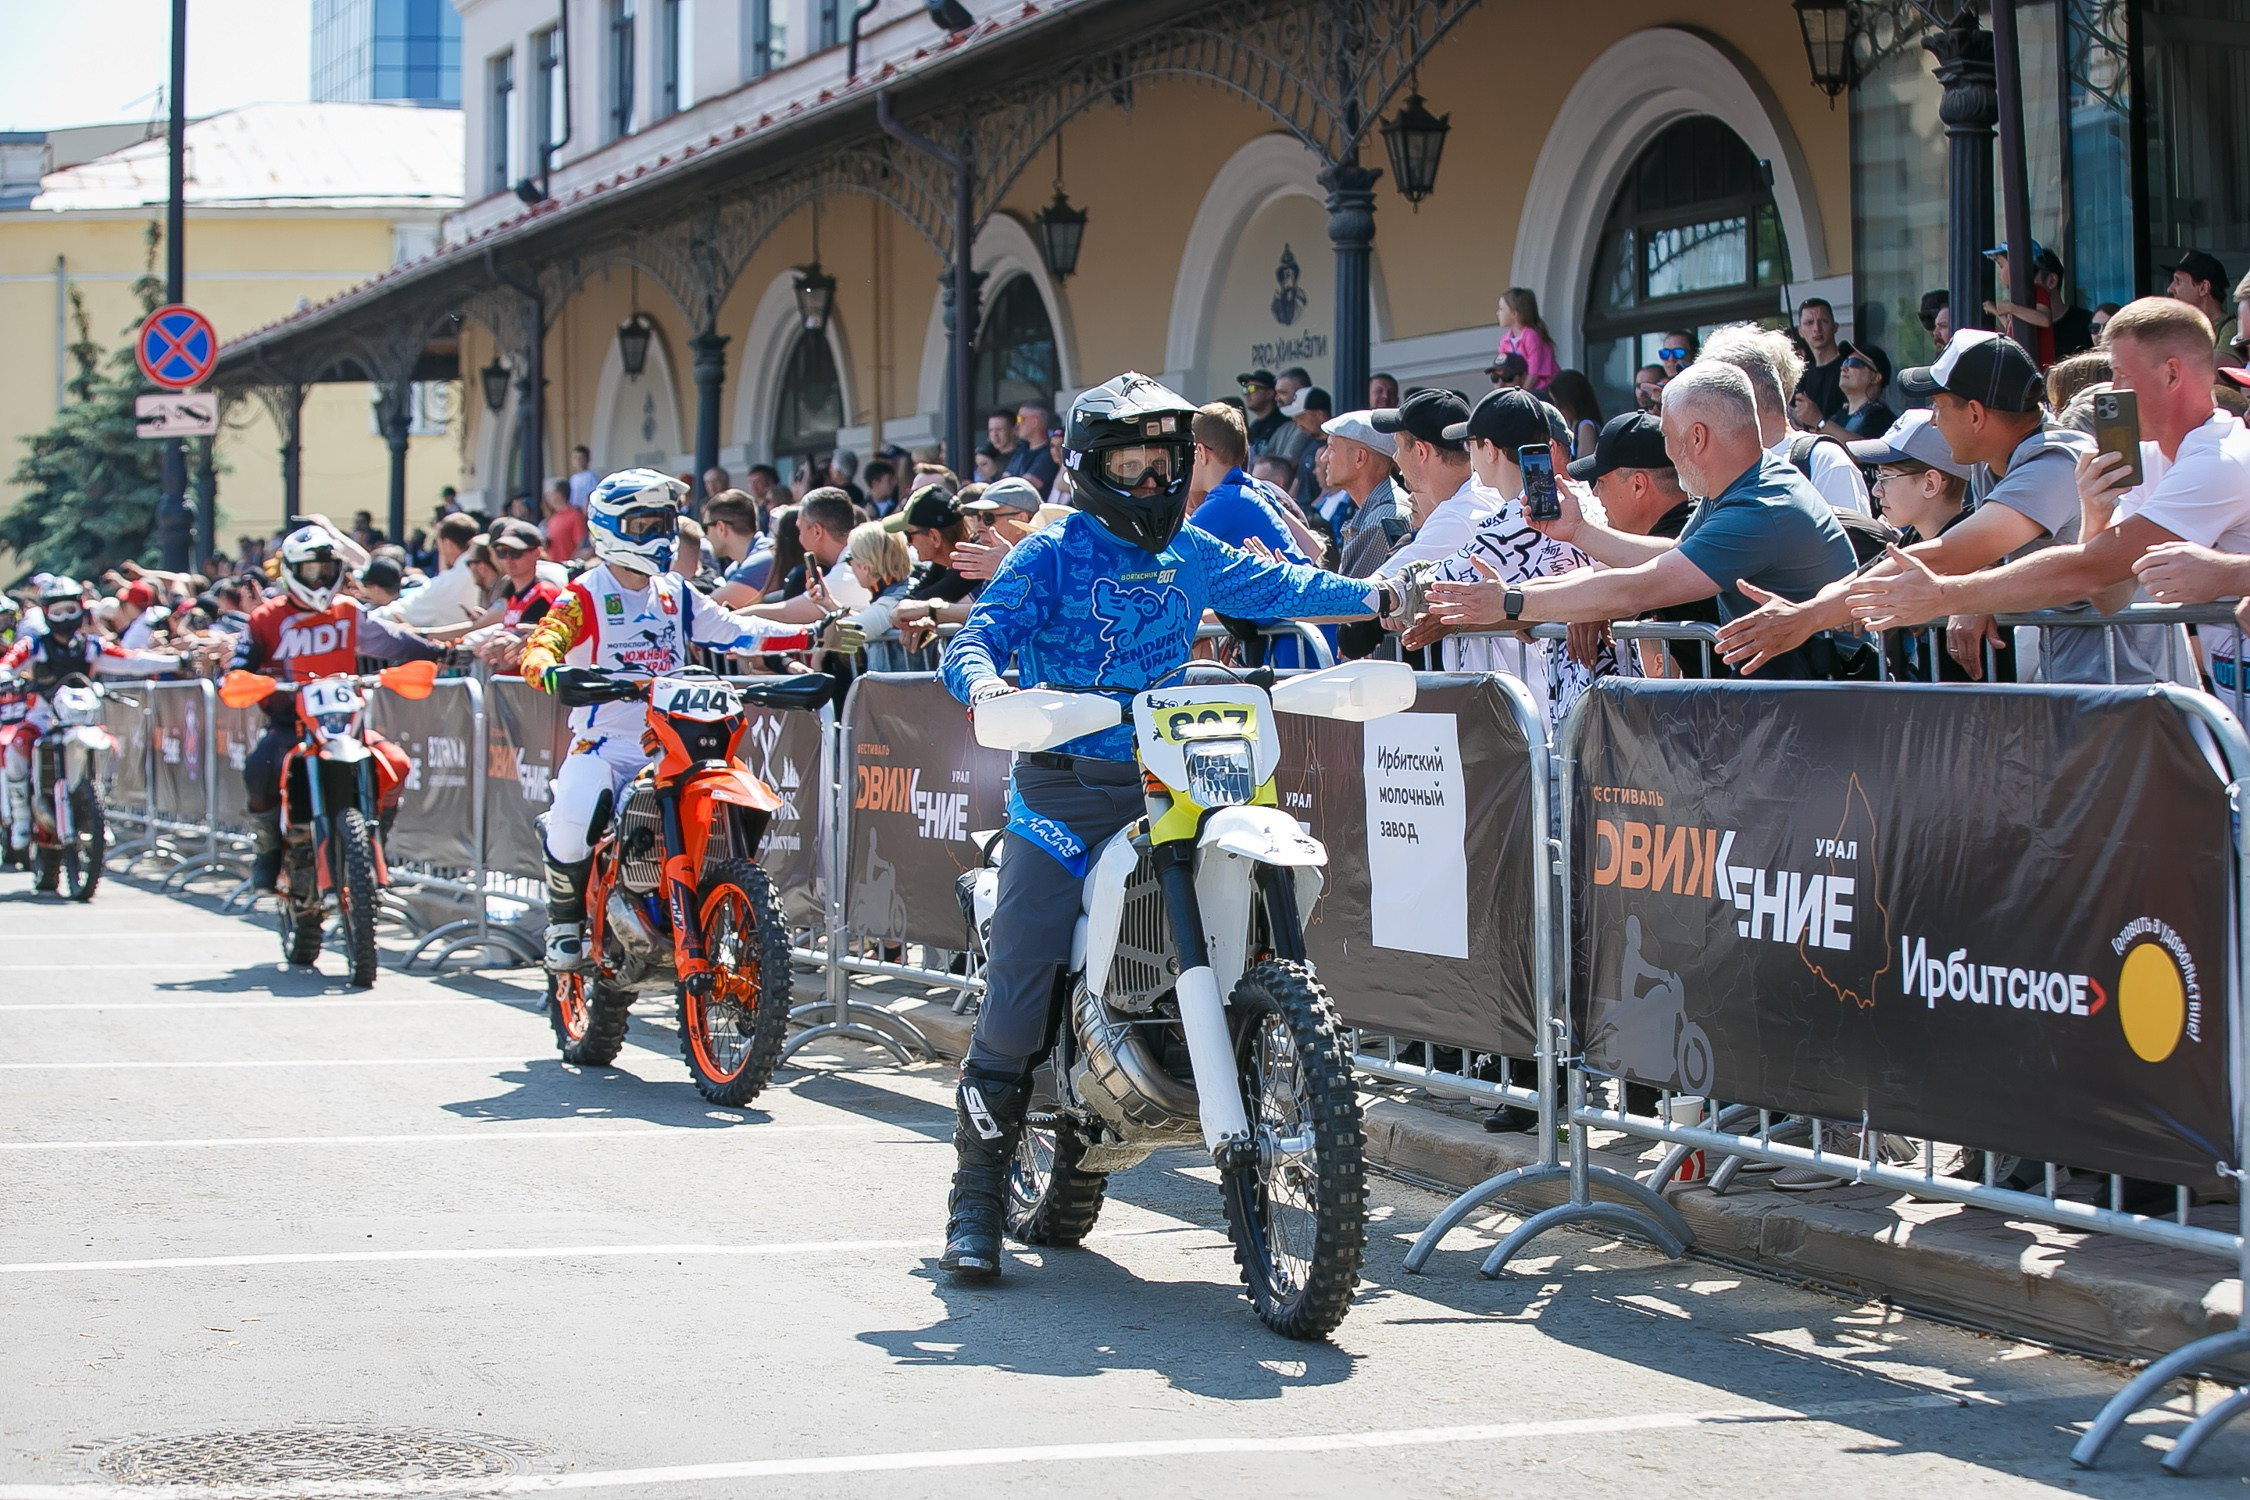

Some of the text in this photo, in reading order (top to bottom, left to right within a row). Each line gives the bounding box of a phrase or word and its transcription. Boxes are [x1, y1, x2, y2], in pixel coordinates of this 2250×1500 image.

[272, 619, 351, 660] MDT
[607, 641, 650, 649] МОТОСПОРТ
[1119, 627, 1186, 666] ENDURO
[623, 646, 670, 662] ЮЖНЫЙ
[645, 660, 672, 672] УРАЛ
[1139, 645, 1180, 673] URAL
[669, 688, 729, 714] 444
[1377, 745, 1445, 776] Ирбитский
[951, 770, 970, 783] УРАЛ
[1285, 791, 1313, 809] УРАЛ
[1379, 781, 1445, 807] молочный
[1380, 820, 1420, 844] завод
[1815, 838, 1858, 860] УРАЛ
[2110, 916, 2153, 956] Готовить
[2159, 922, 2202, 1043] удовольствие!
